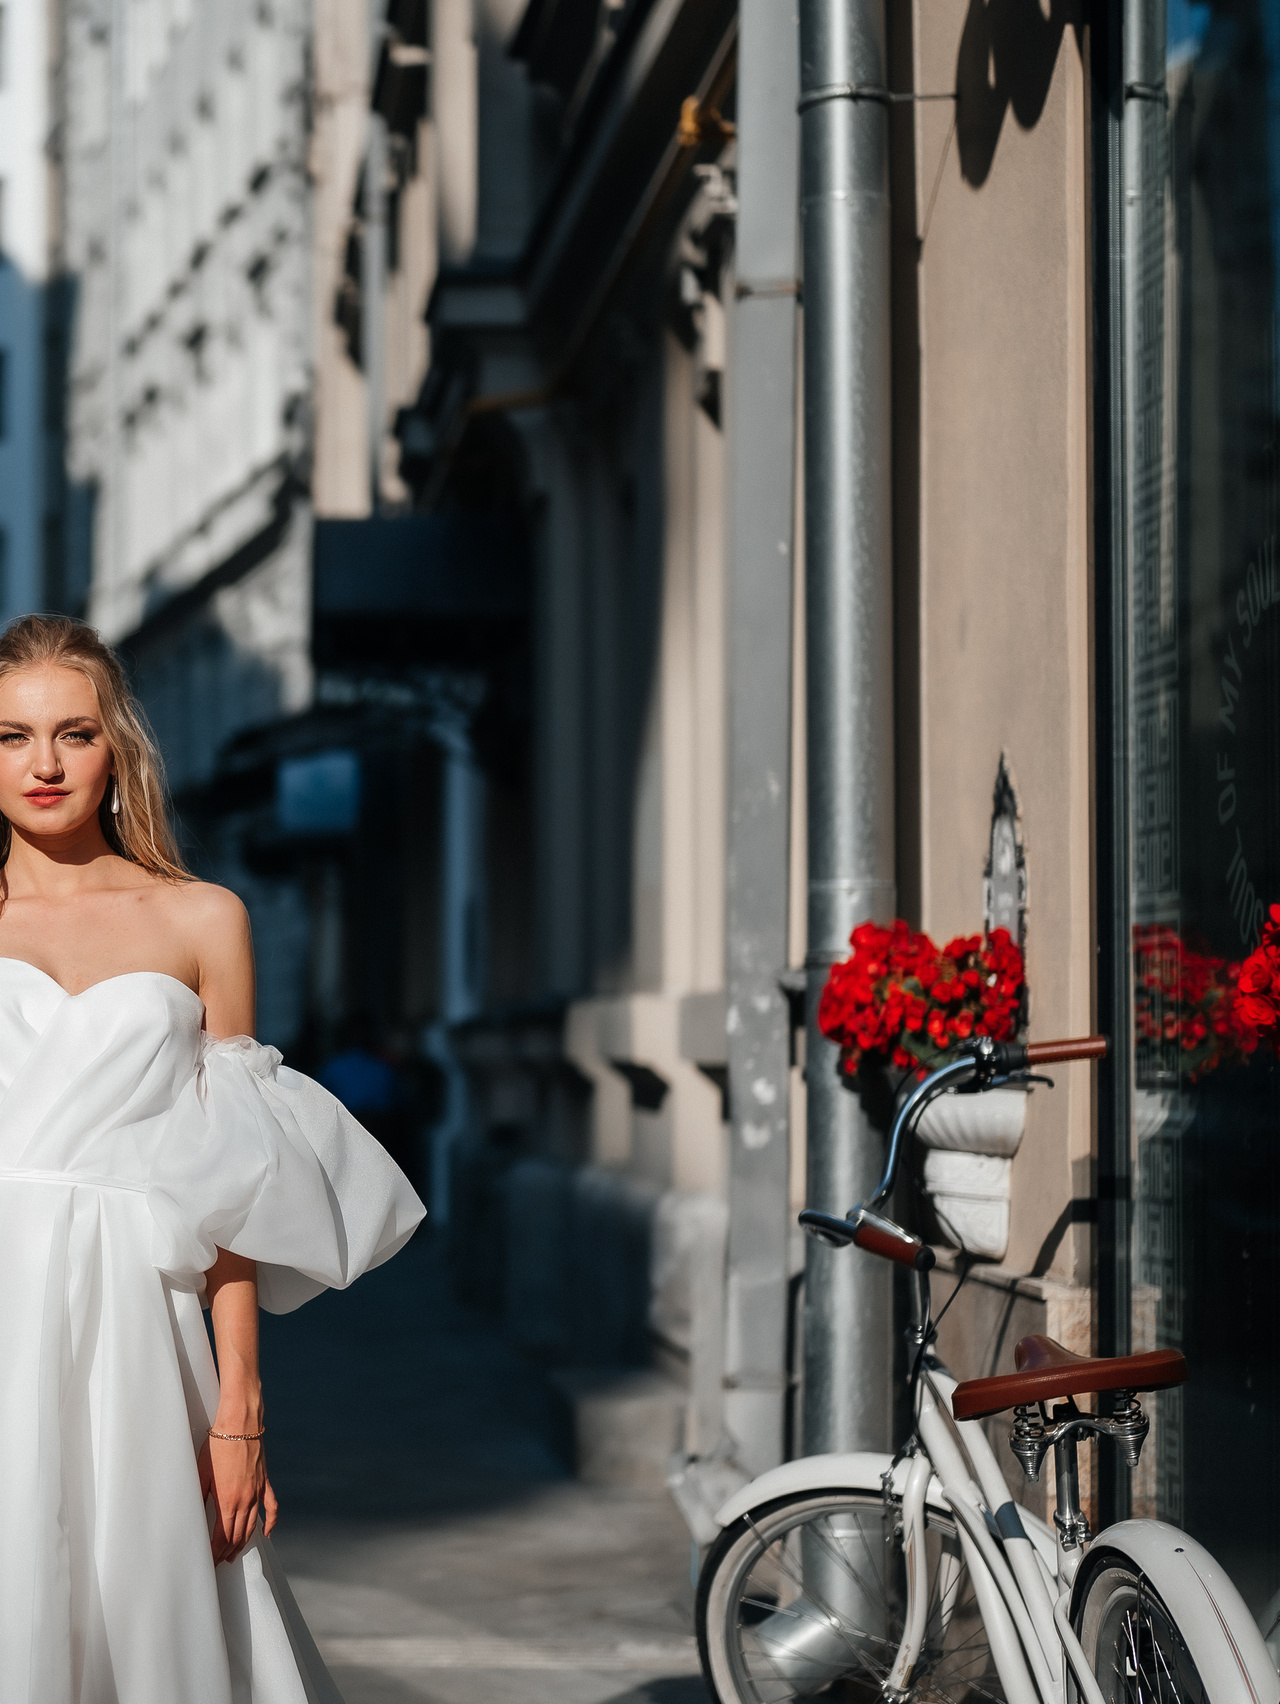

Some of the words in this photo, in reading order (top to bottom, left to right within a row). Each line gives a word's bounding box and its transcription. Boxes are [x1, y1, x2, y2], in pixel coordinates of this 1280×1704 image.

[1236, 534, 1280, 649] SOUL
[1217, 632, 1242, 736] MY
[1216, 752, 1237, 827] OF
